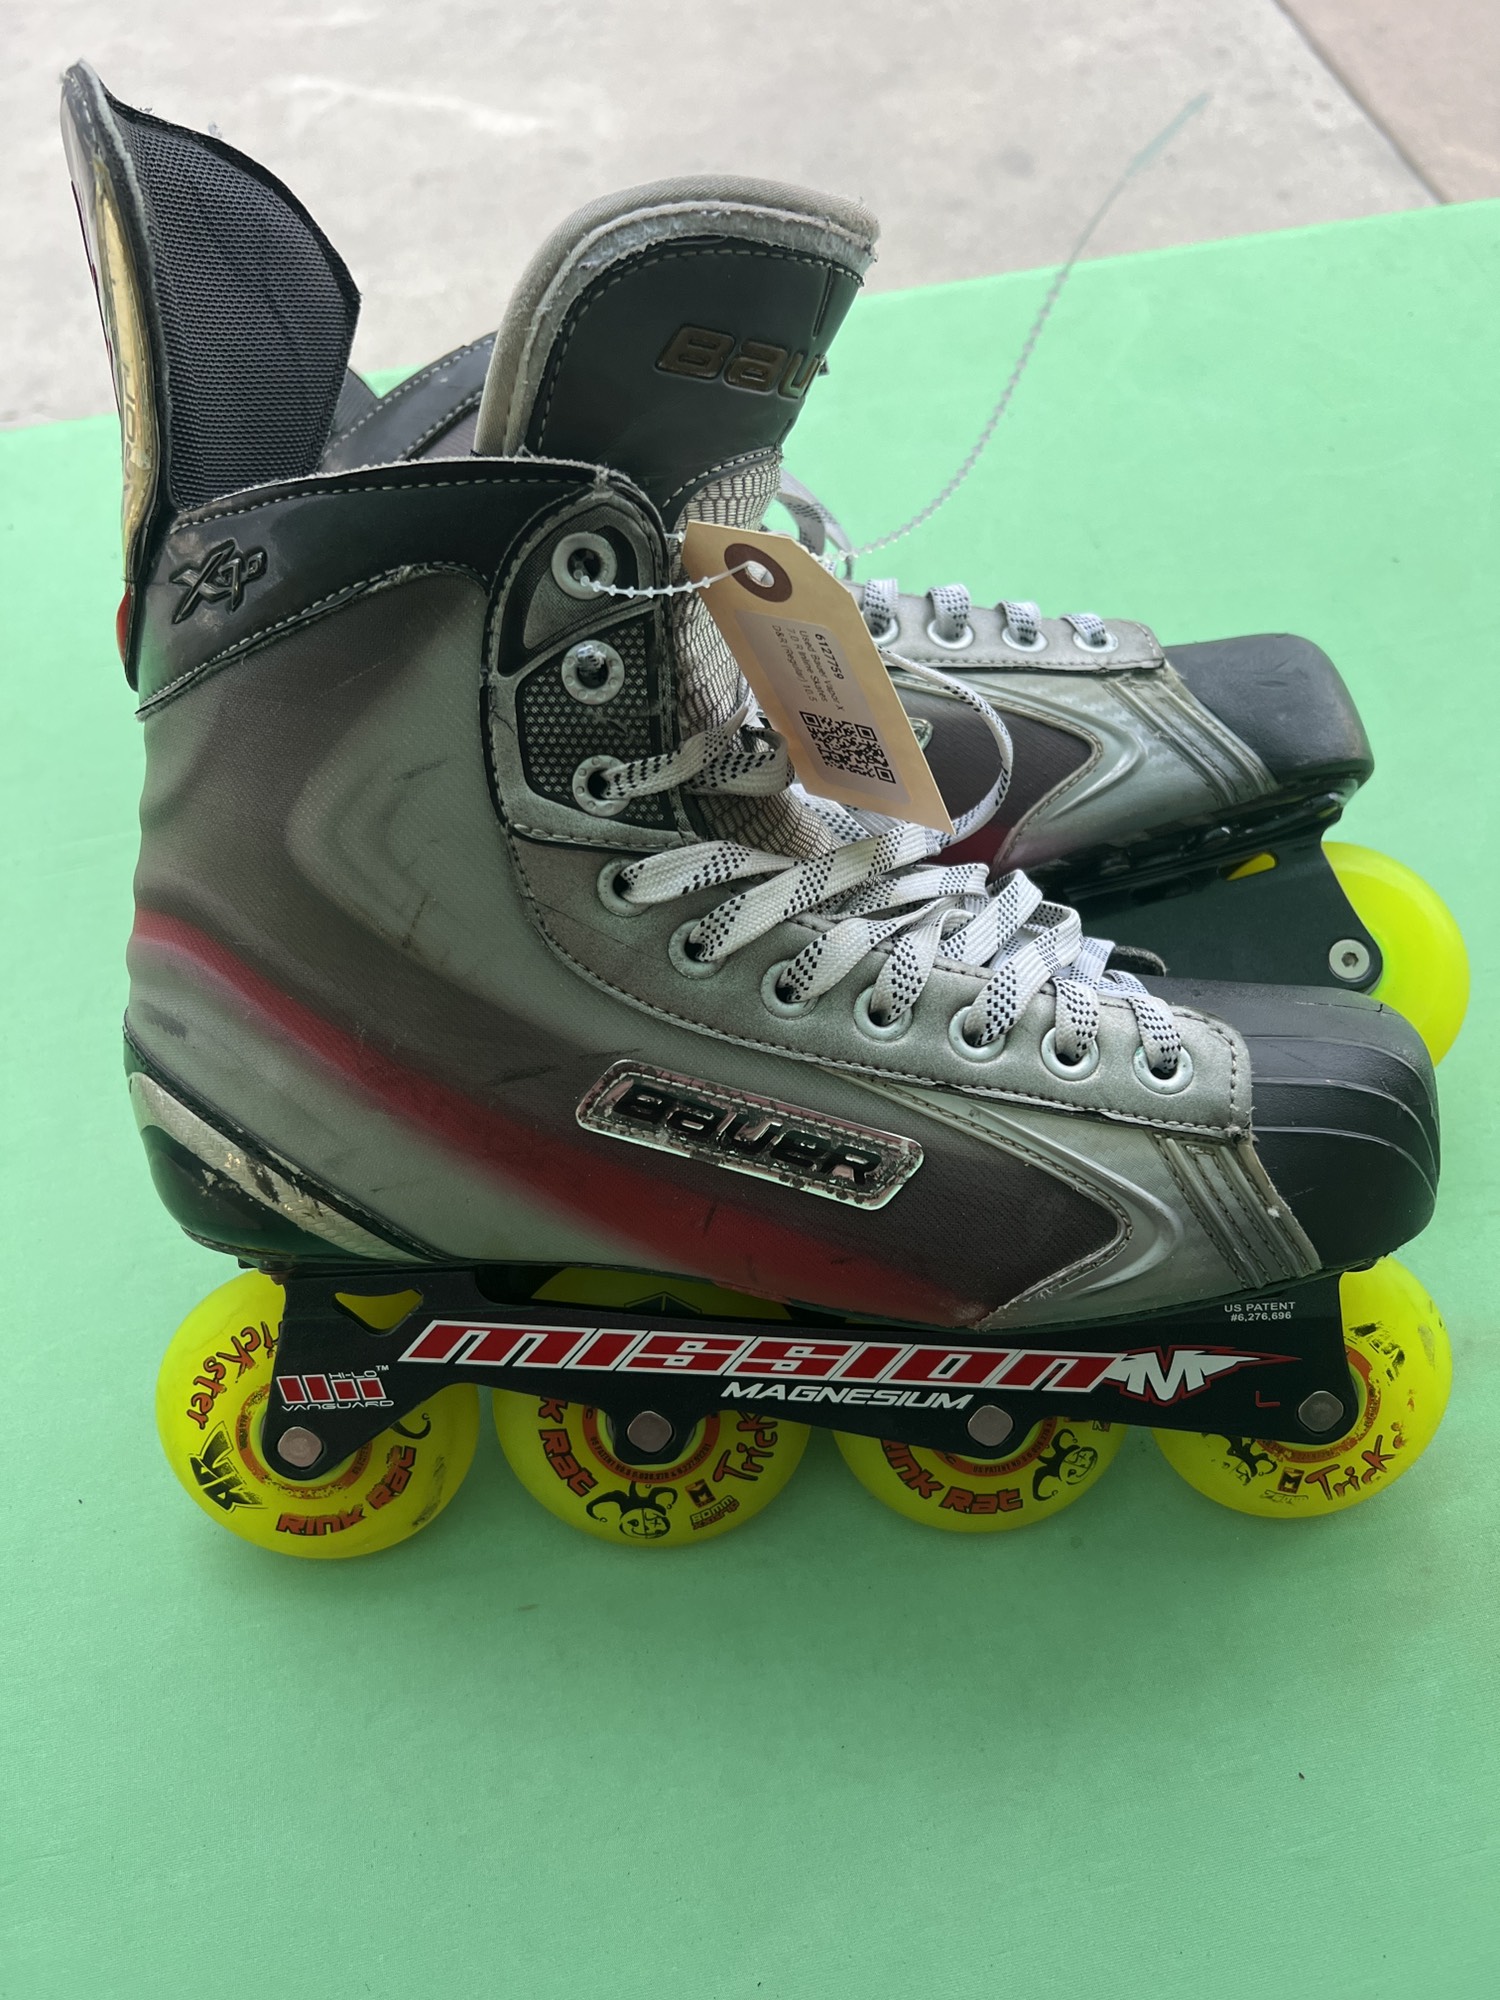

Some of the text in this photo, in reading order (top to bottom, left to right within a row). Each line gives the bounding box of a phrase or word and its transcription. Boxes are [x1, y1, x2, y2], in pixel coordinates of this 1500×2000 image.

[782, 644, 808, 683] (Regular)
[799, 630, 816, 653] Used
[811, 652, 827, 680] Bauer
[824, 679, 841, 706] Vapor
[814, 633, 845, 680] 6127759
[798, 650, 814, 673] Inline
[810, 674, 829, 703] Skates
[1224, 1301, 1296, 1313] US PATENT
[281, 1399, 395, 1412] VANGUARD
[720, 1381, 974, 1410] MAGNESIUM
